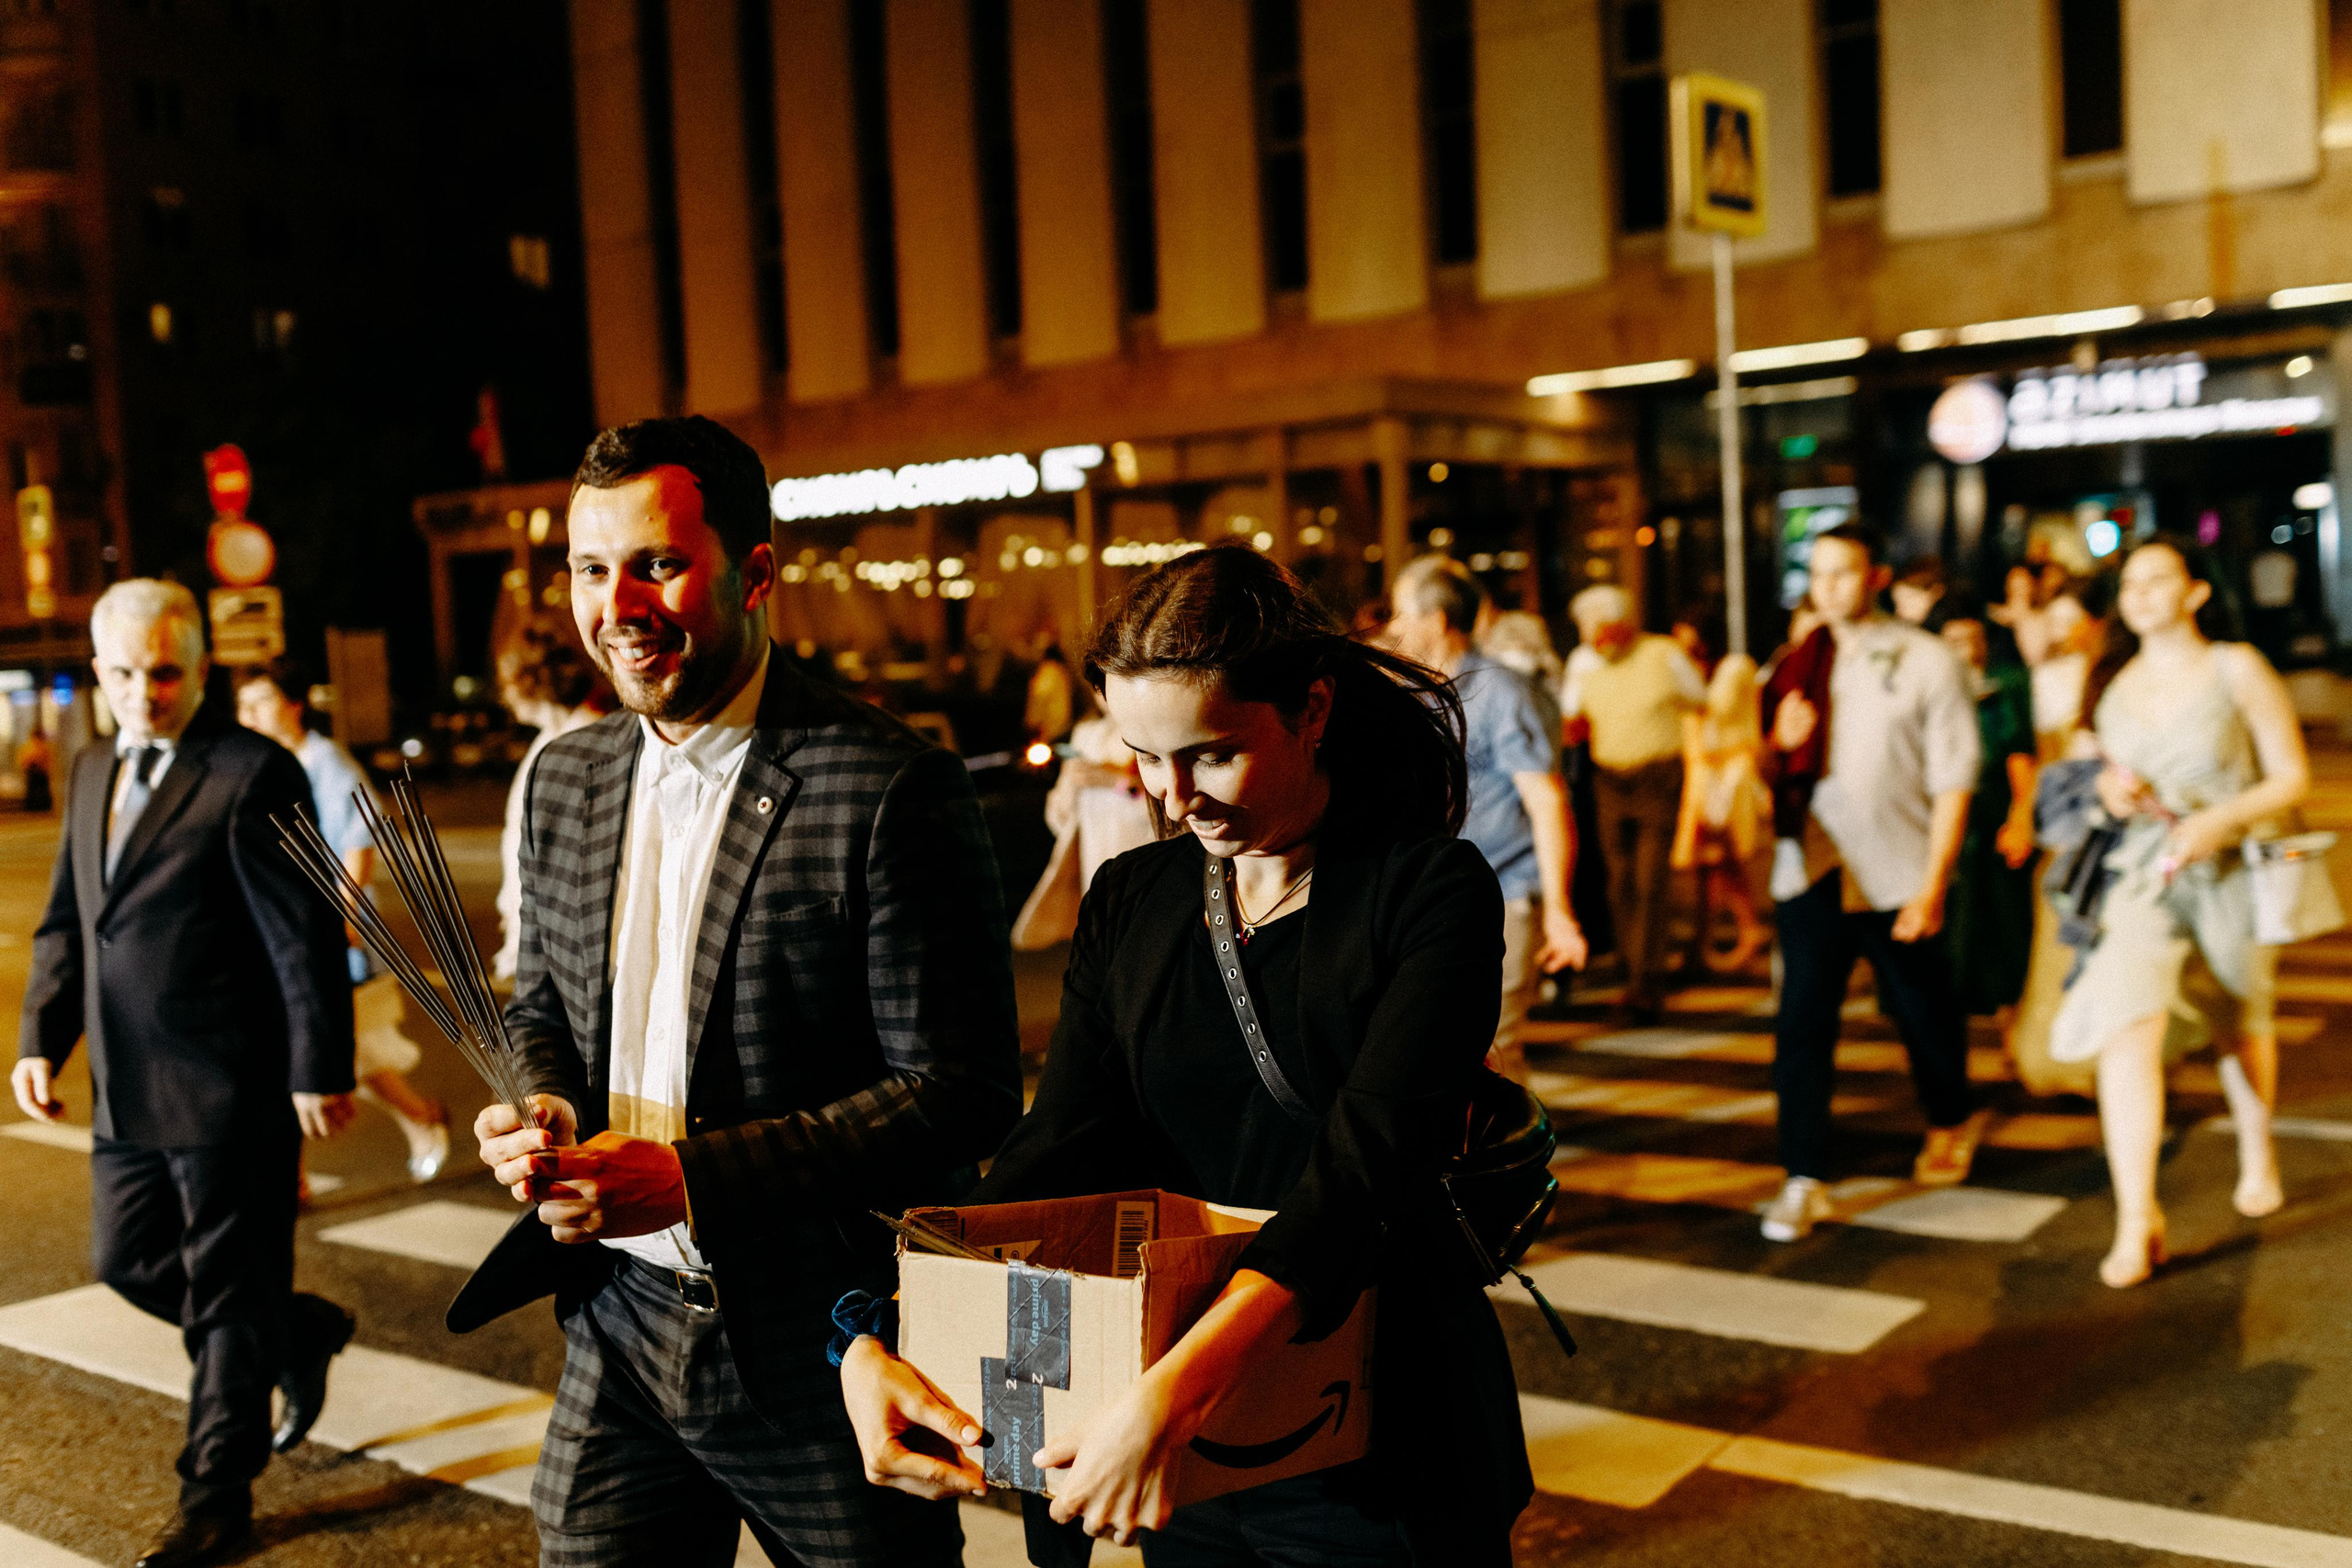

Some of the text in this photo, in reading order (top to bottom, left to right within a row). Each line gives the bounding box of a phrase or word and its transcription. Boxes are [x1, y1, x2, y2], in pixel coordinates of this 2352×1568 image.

[1030, 1278, 1042, 1347] prime day
[1011, 1416, 1023, 1485] prime day
